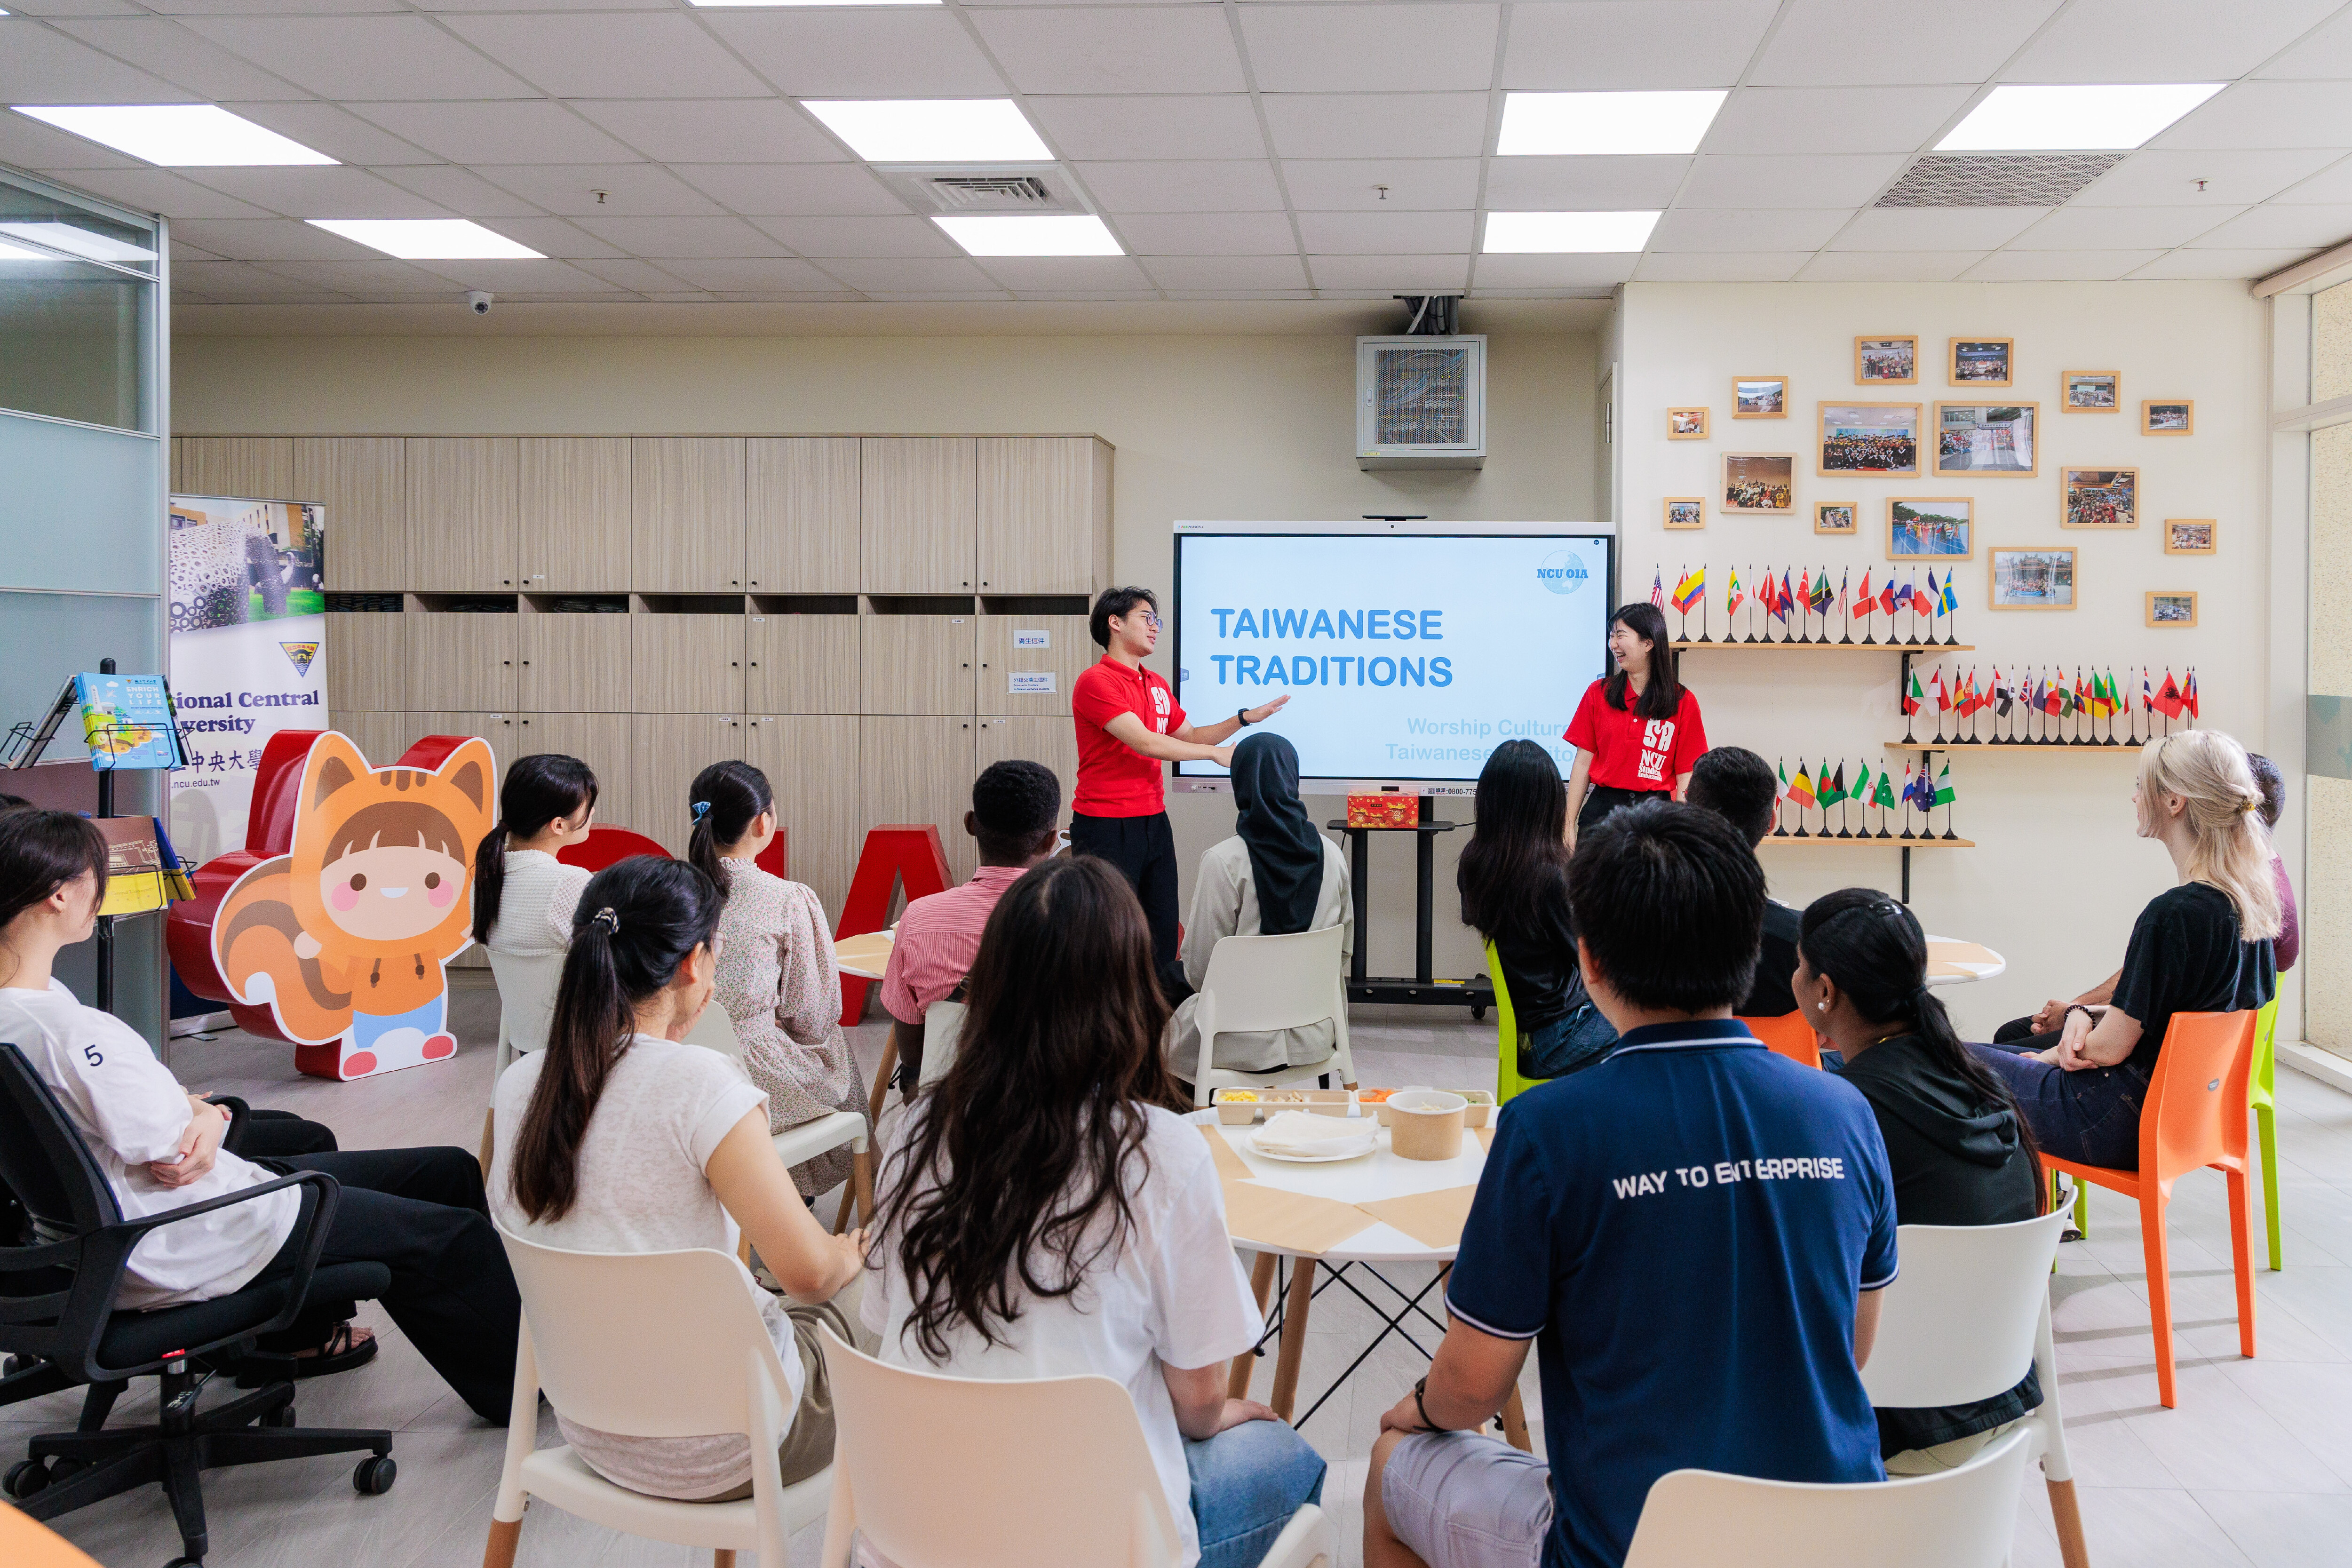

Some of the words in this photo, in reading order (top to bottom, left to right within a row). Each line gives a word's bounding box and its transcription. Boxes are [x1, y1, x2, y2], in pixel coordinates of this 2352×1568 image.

[1537, 569, 1563, 579] NCU
[1565, 569, 1589, 579] OIA
[1210, 608, 1443, 640] TAIWANESE
[1210, 655, 1453, 687] TRADITIONS
[173, 692, 233, 709] ional
[238, 690, 319, 707] Central
[180, 715, 255, 734] versity
[1156, 717, 1168, 734] NC
[1407, 717, 1491, 739] Worship
[170, 749, 262, 773] 中央大學
[1385, 743, 1494, 761] Taiwanese
[1639, 748, 1667, 770] NCU
[171, 779, 220, 789] .ncu.edu.tw
[84, 1044, 103, 1067] 5
[1612, 1170, 1668, 1200] WAY
[1675, 1167, 1709, 1188] TO
[1714, 1157, 1845, 1185] ENTERPRISE
